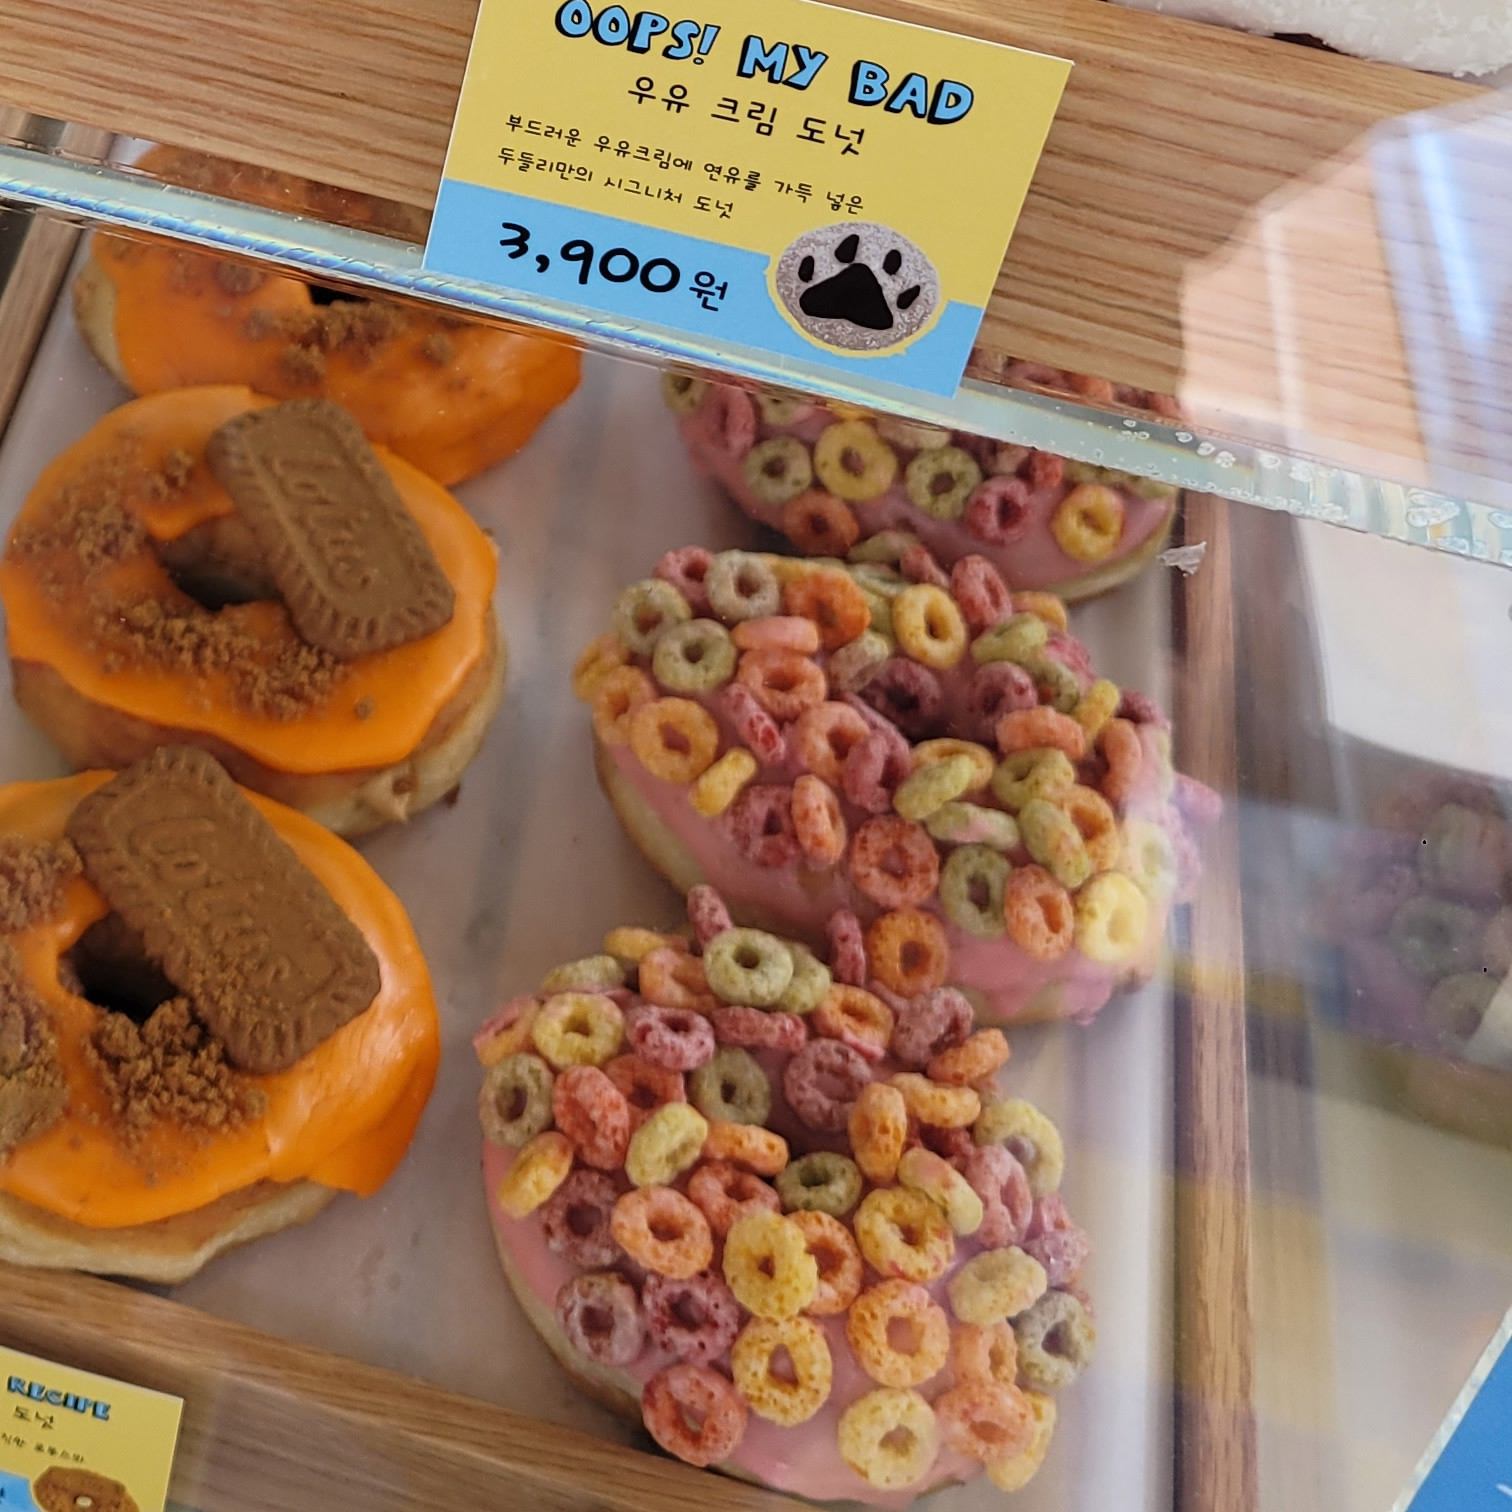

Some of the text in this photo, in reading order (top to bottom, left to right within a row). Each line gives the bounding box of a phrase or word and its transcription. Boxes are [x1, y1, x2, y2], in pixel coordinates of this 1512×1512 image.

[629, 75, 866, 156] 우유 크림 도넛
[738, 35, 827, 90] MY
[849, 60, 974, 126] BAD
[498, 147, 735, 221] 두들리만의 시그니처 도넛
[504, 114, 864, 214] 부드러운 우유크림에 연유를 가득 넣은
[7, 1375, 111, 1421] RECIPE
[13, 1405, 55, 1429] 도넛
